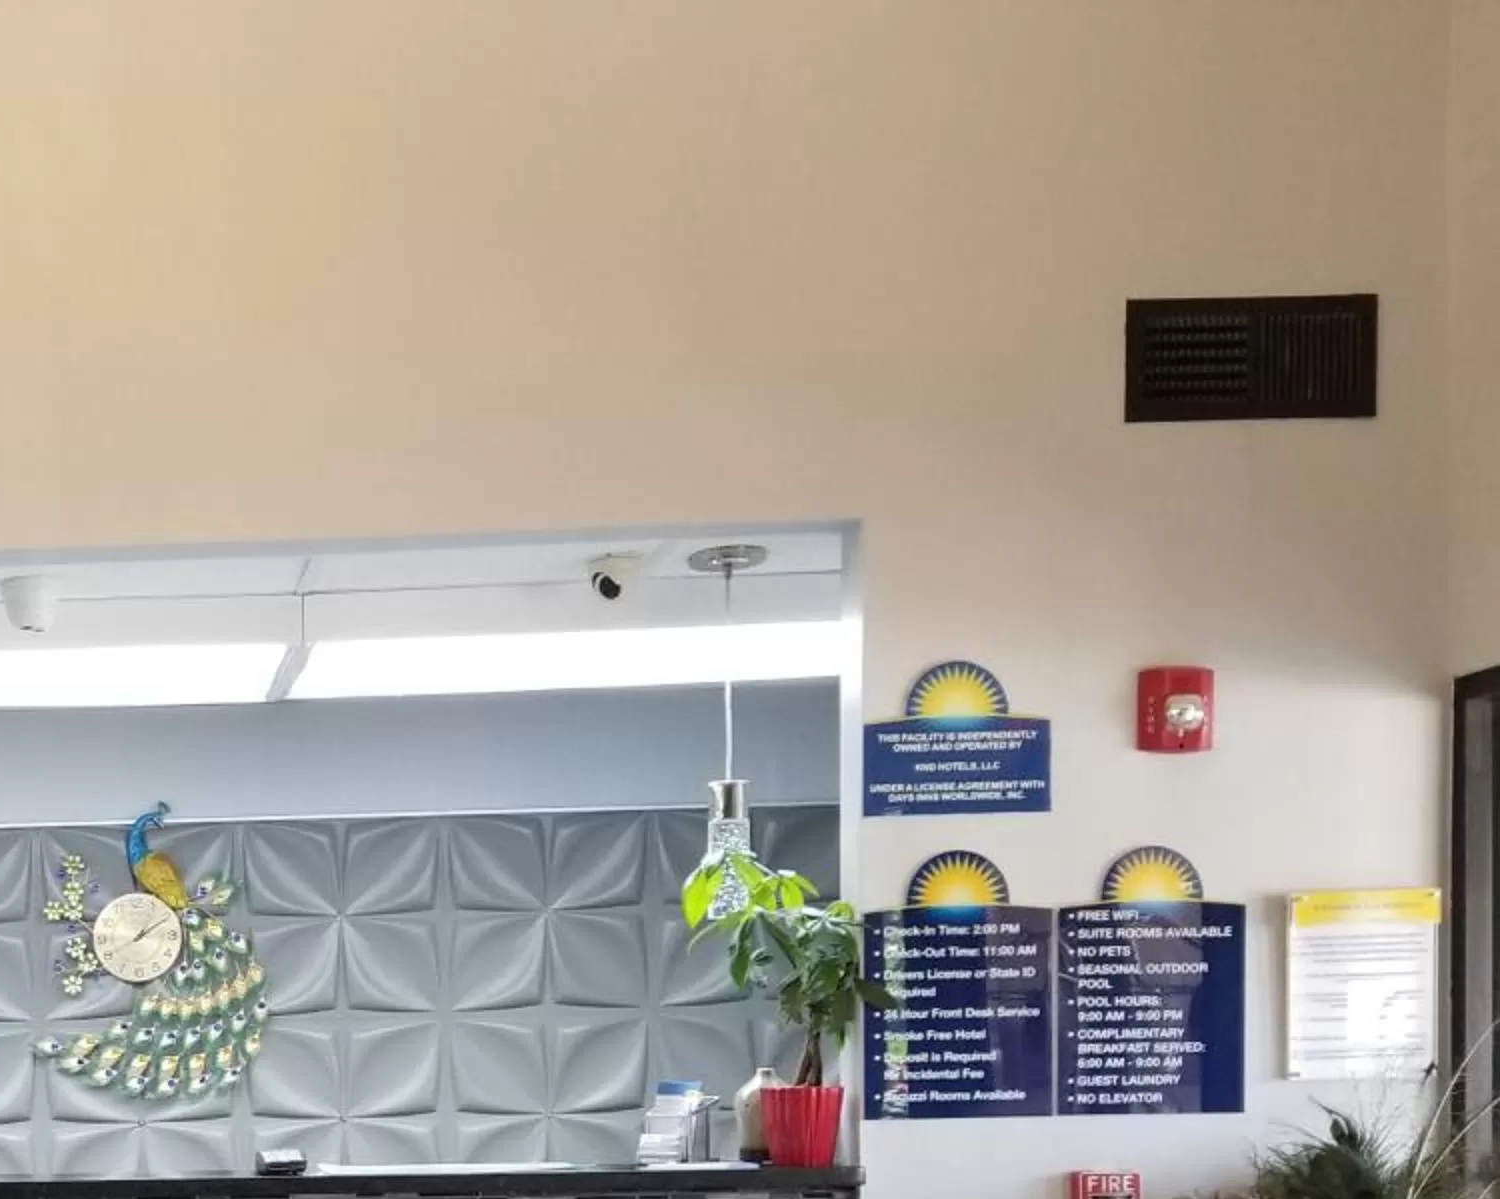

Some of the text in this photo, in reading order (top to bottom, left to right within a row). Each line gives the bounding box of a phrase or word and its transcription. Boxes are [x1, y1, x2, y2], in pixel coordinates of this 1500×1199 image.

[877, 730, 1038, 743] THIS FACILITY IS INDEPENDENTLY
[892, 740, 1022, 752] OWNED AND OPERATED BY
[981, 761, 1001, 770] LLC
[869, 780, 1045, 793] UNDER A LICENSE AGREEMENT WITH
[888, 793, 914, 803] DAYS
[1077, 909, 1139, 921] FREE WIFI
[883, 923, 1021, 938] Check-In Time: 2:00 PM
[1077, 926, 1233, 939] SUITE ROOMS AVAILABLE
[948, 947, 981, 957] Time:
[983, 946, 1014, 956] 11:00
[1016, 945, 1037, 956] AM
[1077, 946, 1131, 957] NO PETS
[883, 966, 1036, 981] Drivers License or State ID
[1077, 962, 1209, 975] SEASONAL OUTDOOR
[1077, 978, 1113, 989] POOL
[1077, 995, 1163, 1008] POOL HOURS:
[900, 1009, 929, 1019] Hour
[931, 1007, 964, 1018] Front
[965, 1007, 995, 1018] Desk
[997, 1006, 1040, 1017] Service
[1077, 1011, 1103, 1022] 9:00
[1105, 1010, 1125, 1022] AM
[1135, 1010, 1161, 1021] 9:00
[1163, 1010, 1183, 1020] PM
[883, 1028, 987, 1041] Smoke Free Hotel
[1077, 1027, 1185, 1039] COMPLIMENTARY
[1077, 1041, 1207, 1054] BREAKFAST SERVED:
[883, 1050, 997, 1065] Deposit is Required
[1105, 1057, 1125, 1068] AM
[1135, 1057, 1161, 1067] 9:00
[1163, 1056, 1183, 1067] AM
[902, 1068, 960, 1080] Incidental
[962, 1068, 985, 1079] Fee
[1076, 1074, 1182, 1086] GUEST LAUNDRY
[929, 1090, 971, 1101] Rooms
[973, 1089, 1026, 1100] Available
[1076, 1092, 1163, 1104] NO ELEVATOR
[1087, 1175, 1137, 1193] FIRE
